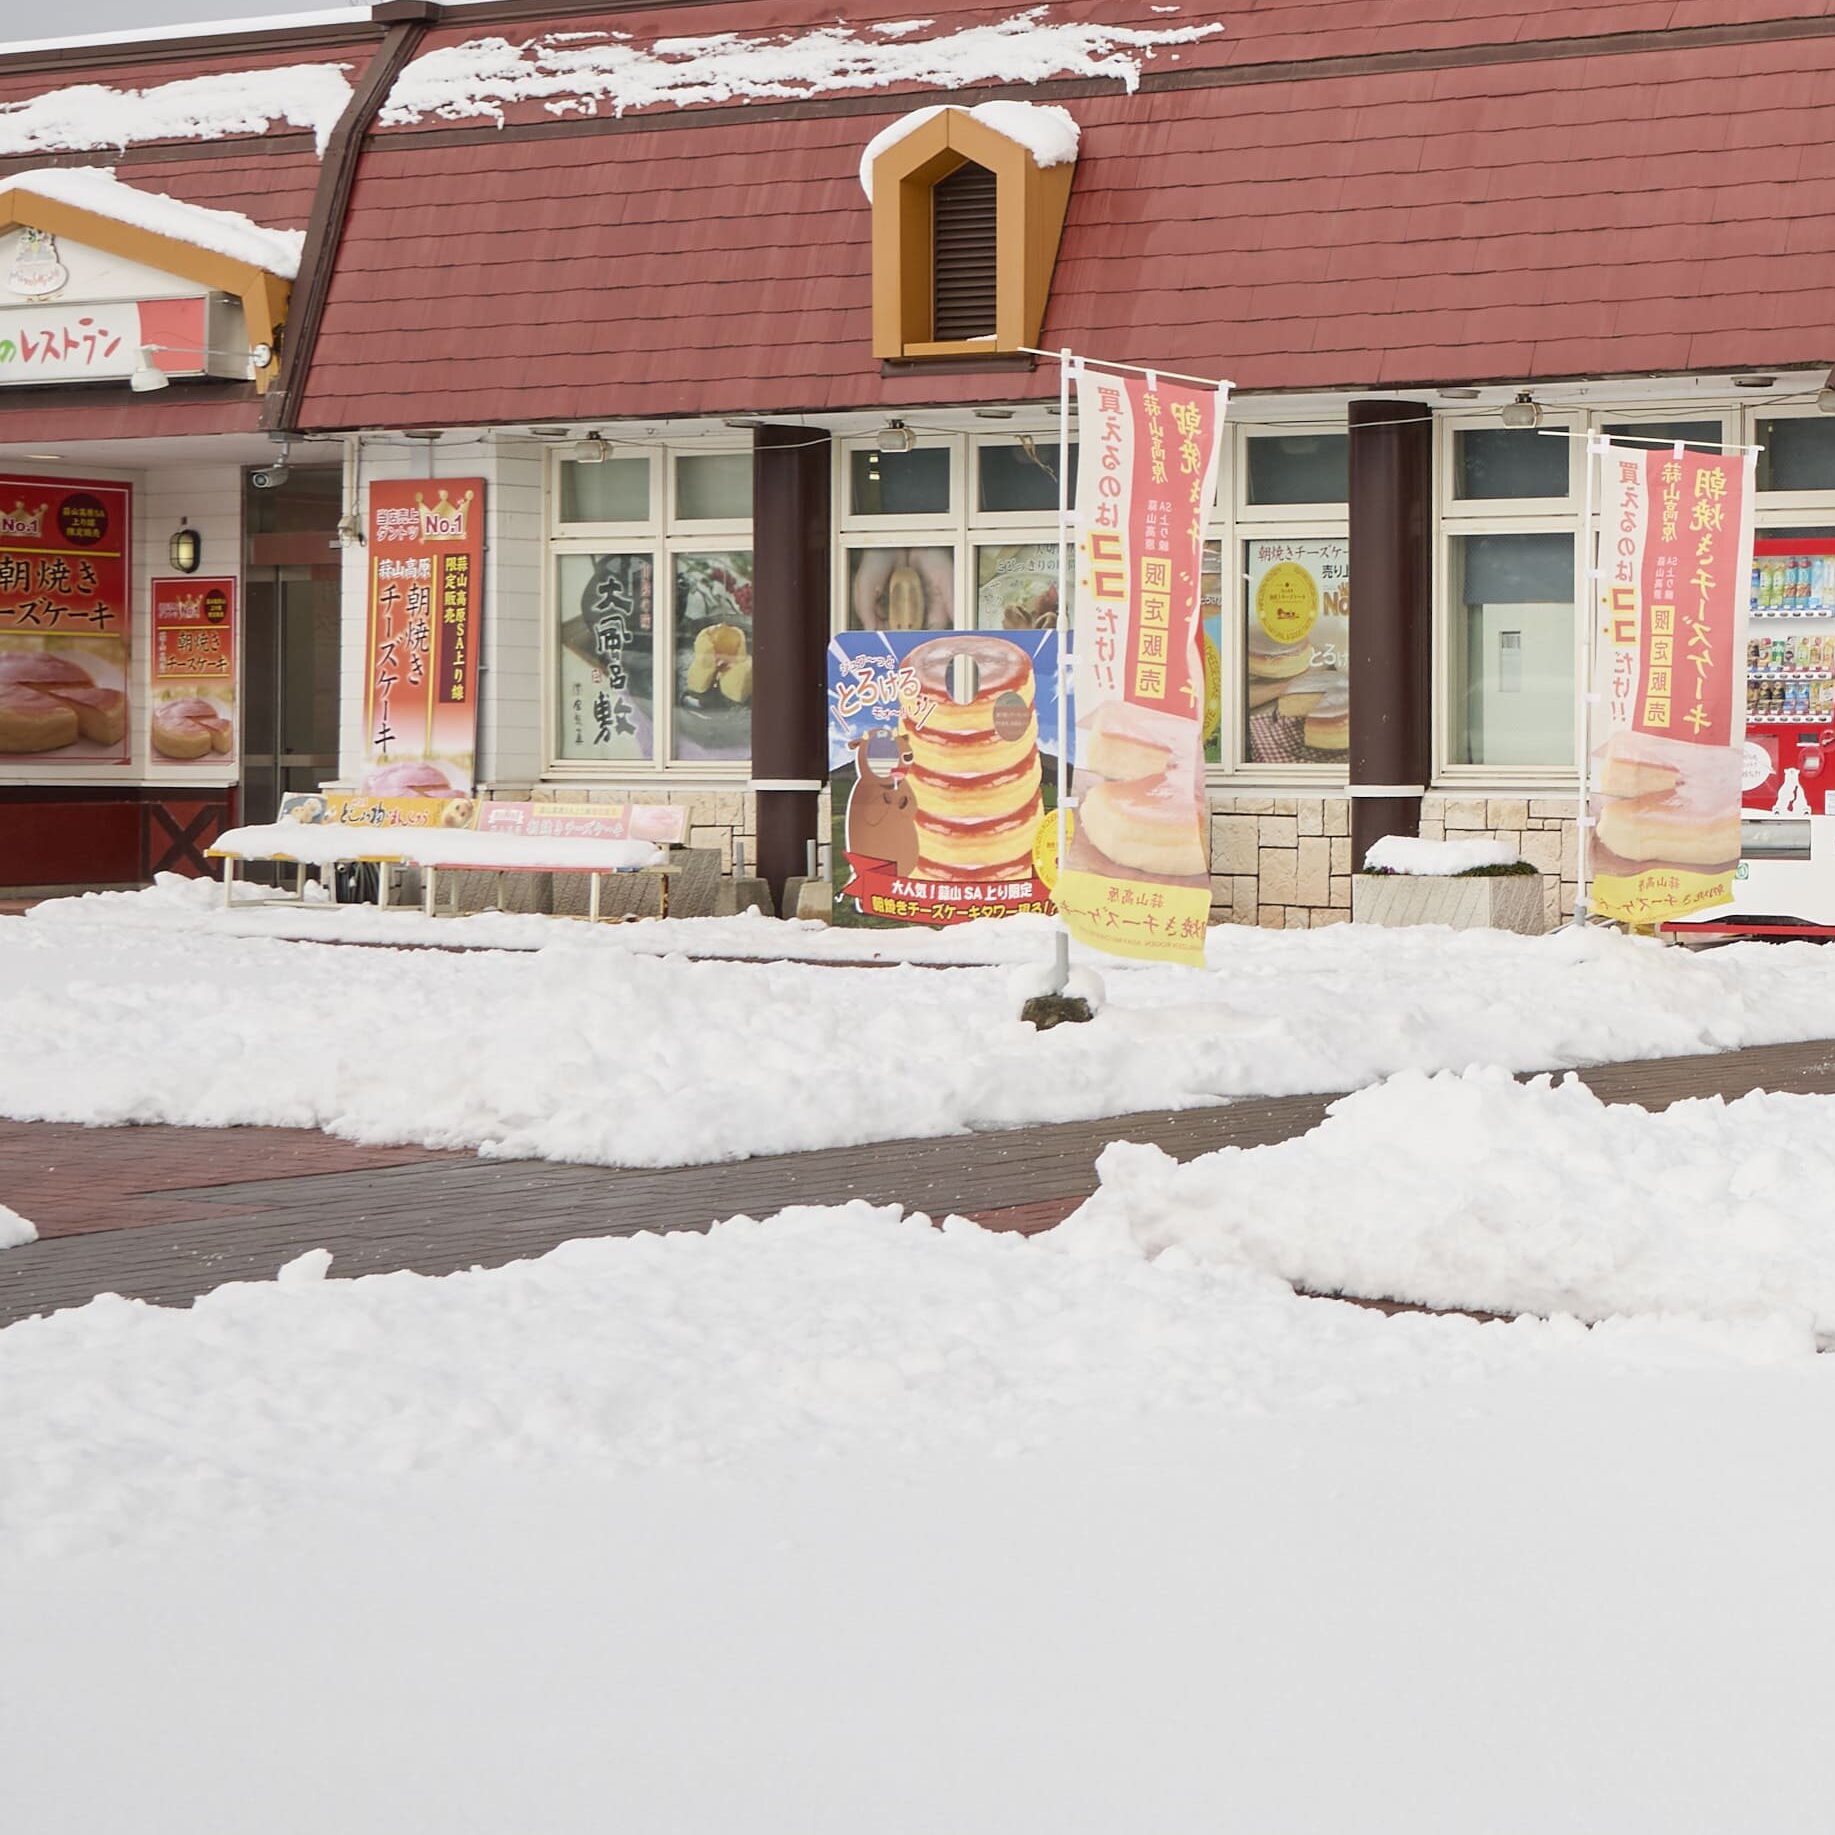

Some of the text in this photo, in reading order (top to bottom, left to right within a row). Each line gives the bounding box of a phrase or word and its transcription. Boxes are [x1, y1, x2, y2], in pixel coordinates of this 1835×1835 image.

[425, 514, 464, 535] No.1
[374, 584, 403, 754] チーズケーキ
[404, 583, 431, 687] 朝焼き
[836, 666, 922, 718] とろける
